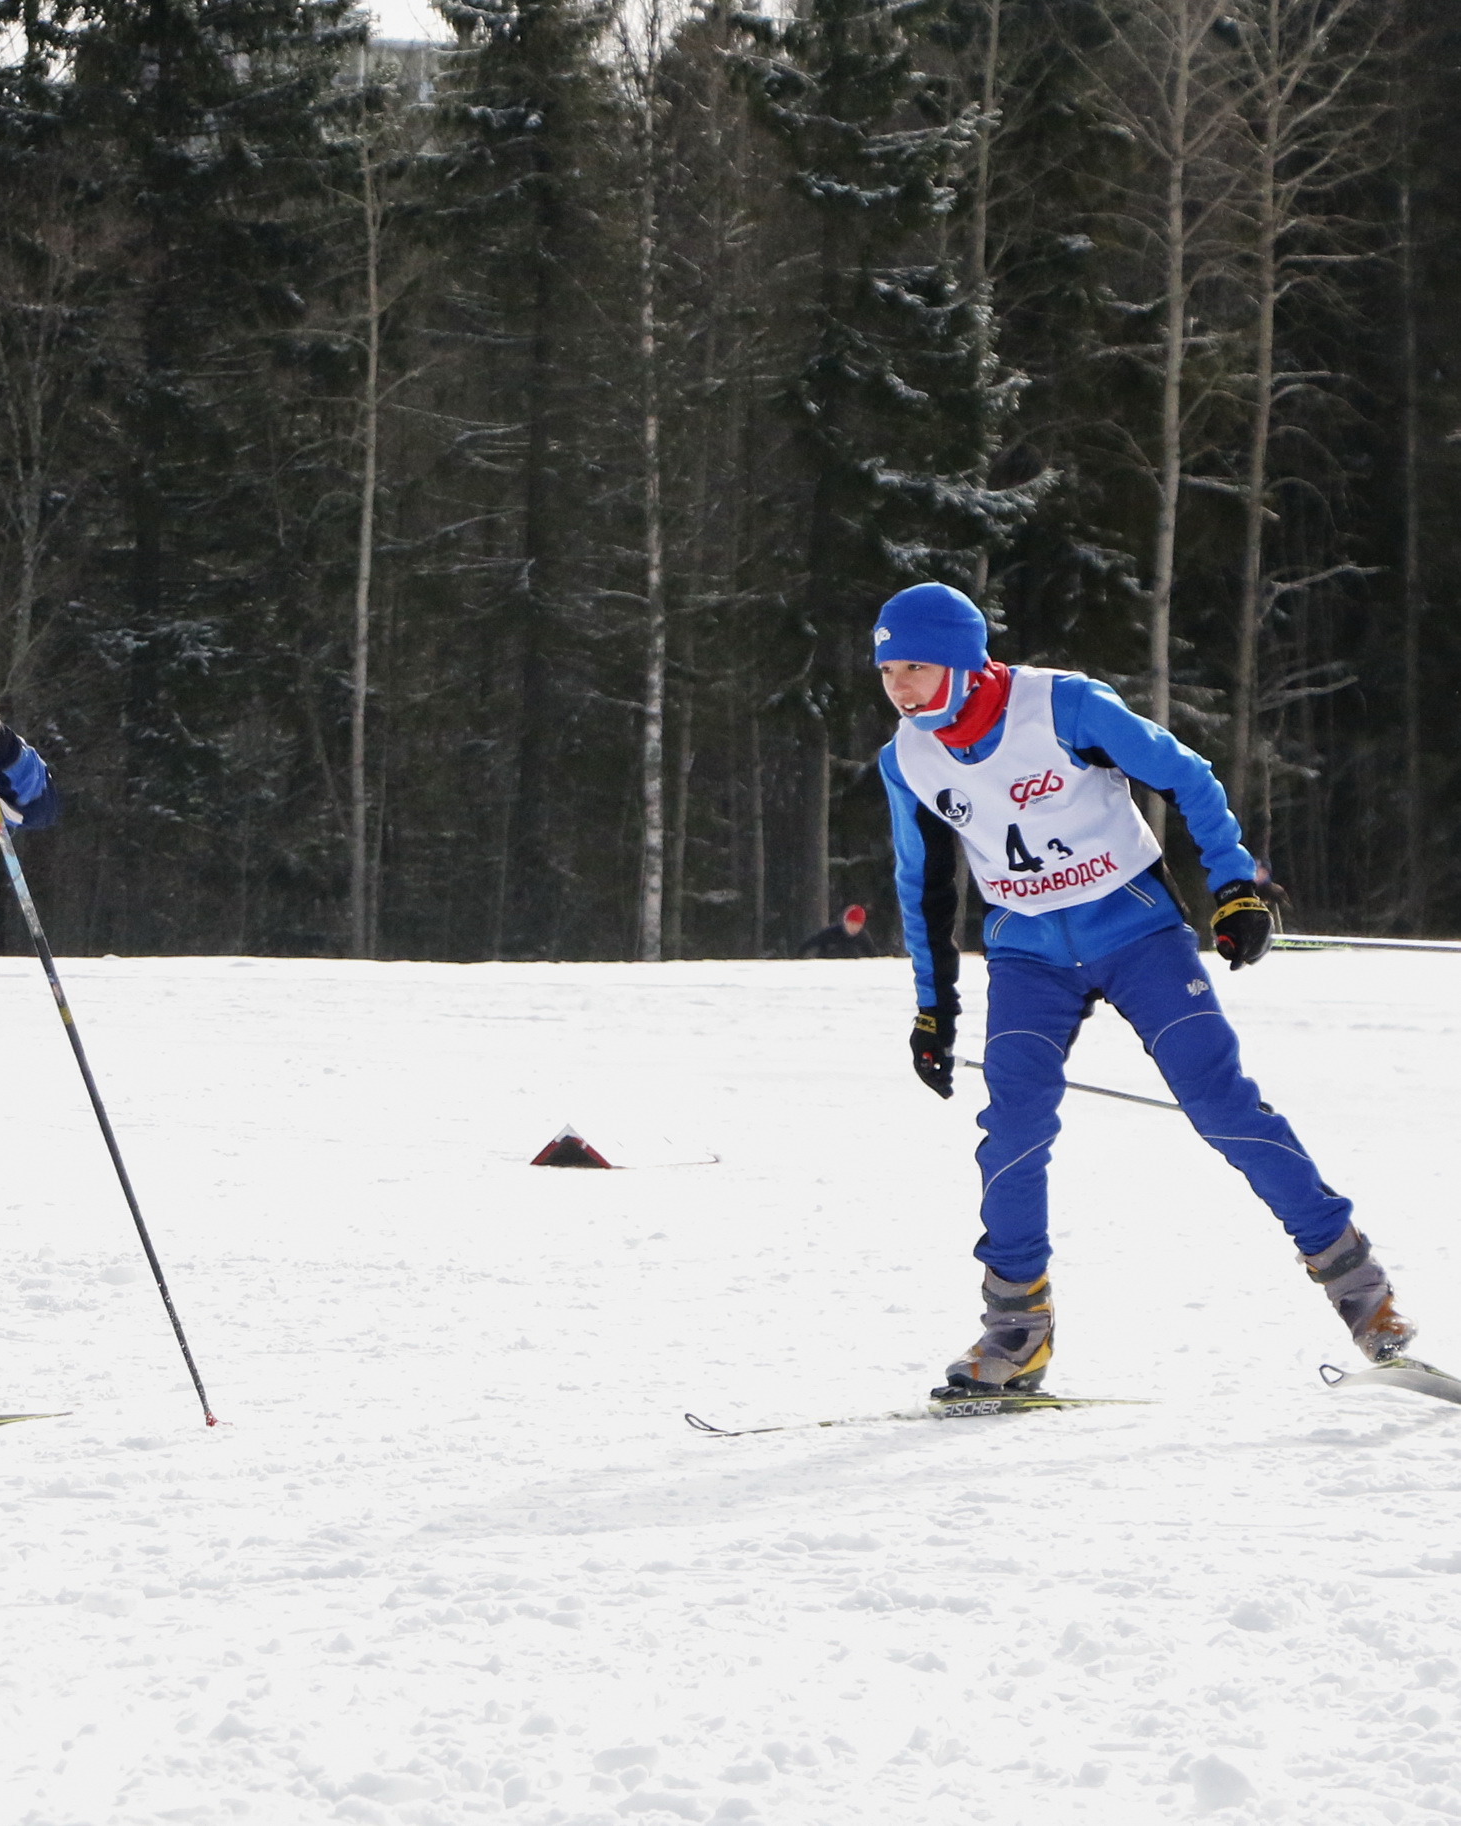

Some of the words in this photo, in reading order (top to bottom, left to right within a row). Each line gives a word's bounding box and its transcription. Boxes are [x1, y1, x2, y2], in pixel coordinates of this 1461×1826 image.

[1005, 823, 1045, 873] 4
[1047, 838, 1074, 860] 3
[944, 1400, 1002, 1416] FISCHER
